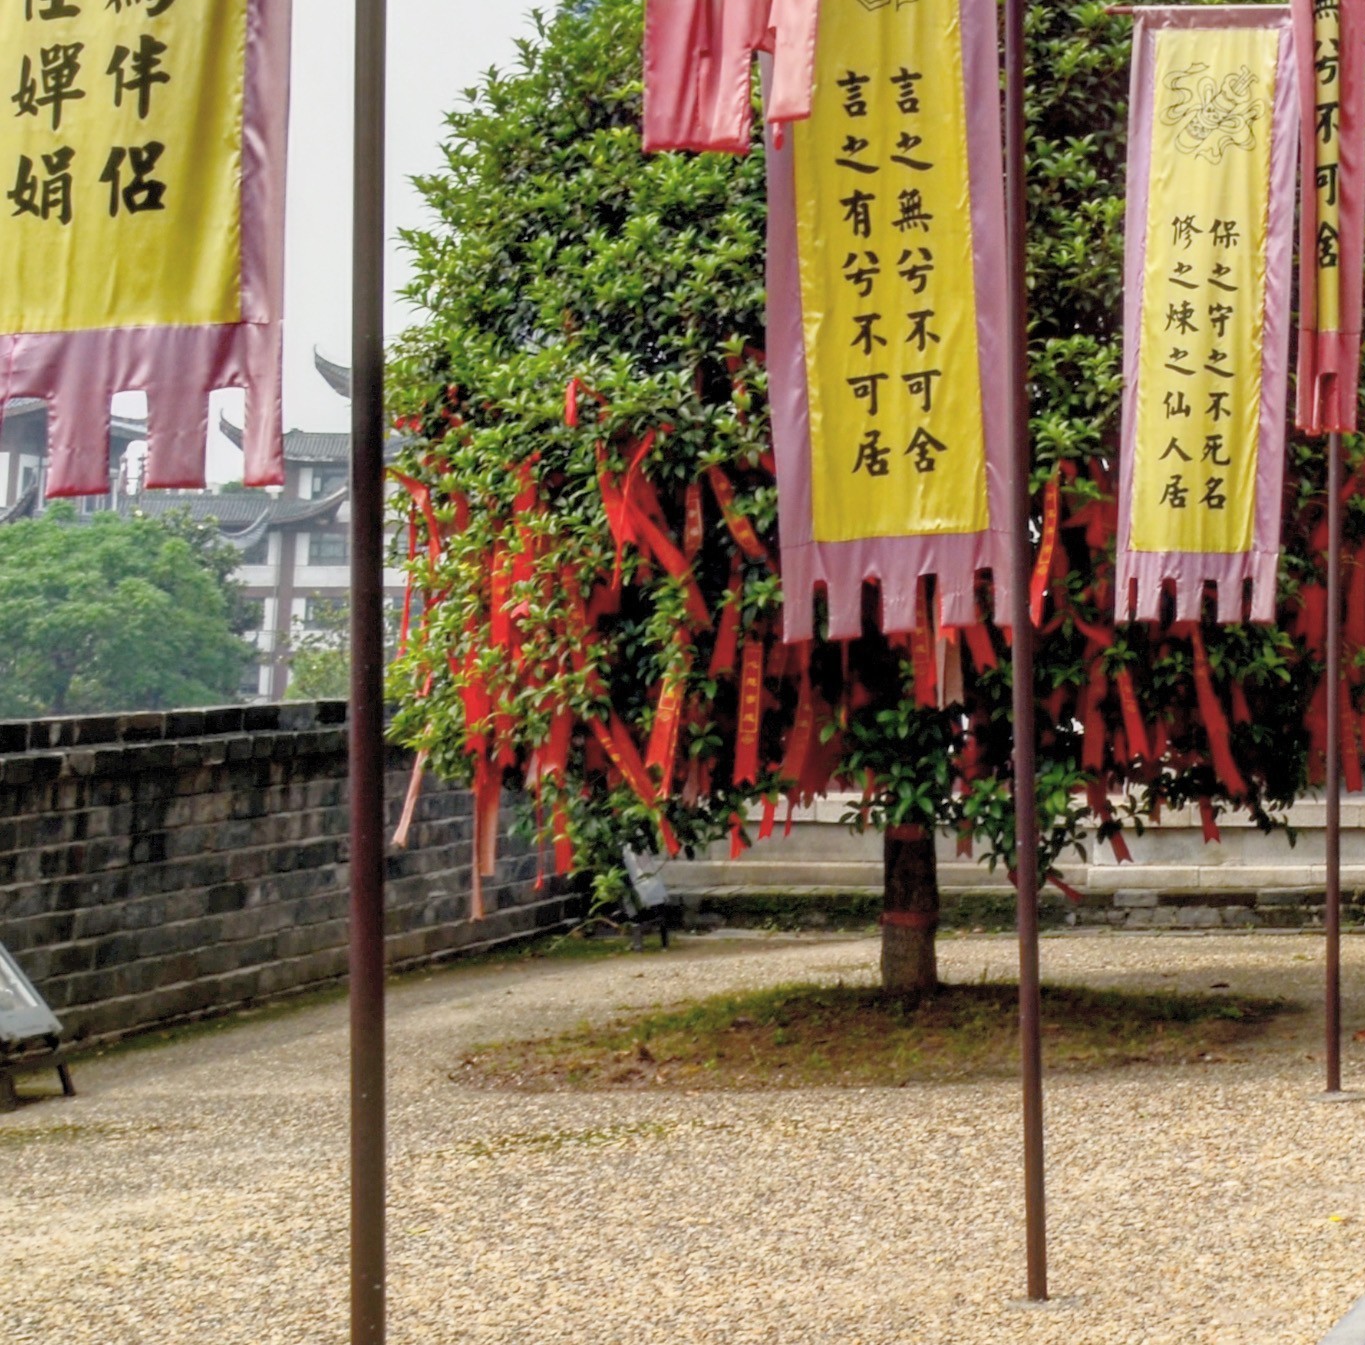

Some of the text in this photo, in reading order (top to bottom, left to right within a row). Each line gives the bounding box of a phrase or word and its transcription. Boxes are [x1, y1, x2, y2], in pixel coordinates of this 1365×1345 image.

[834, 70, 892, 478] 言之有兮不可居
[1199, 218, 1240, 510] 保之守之不死名
